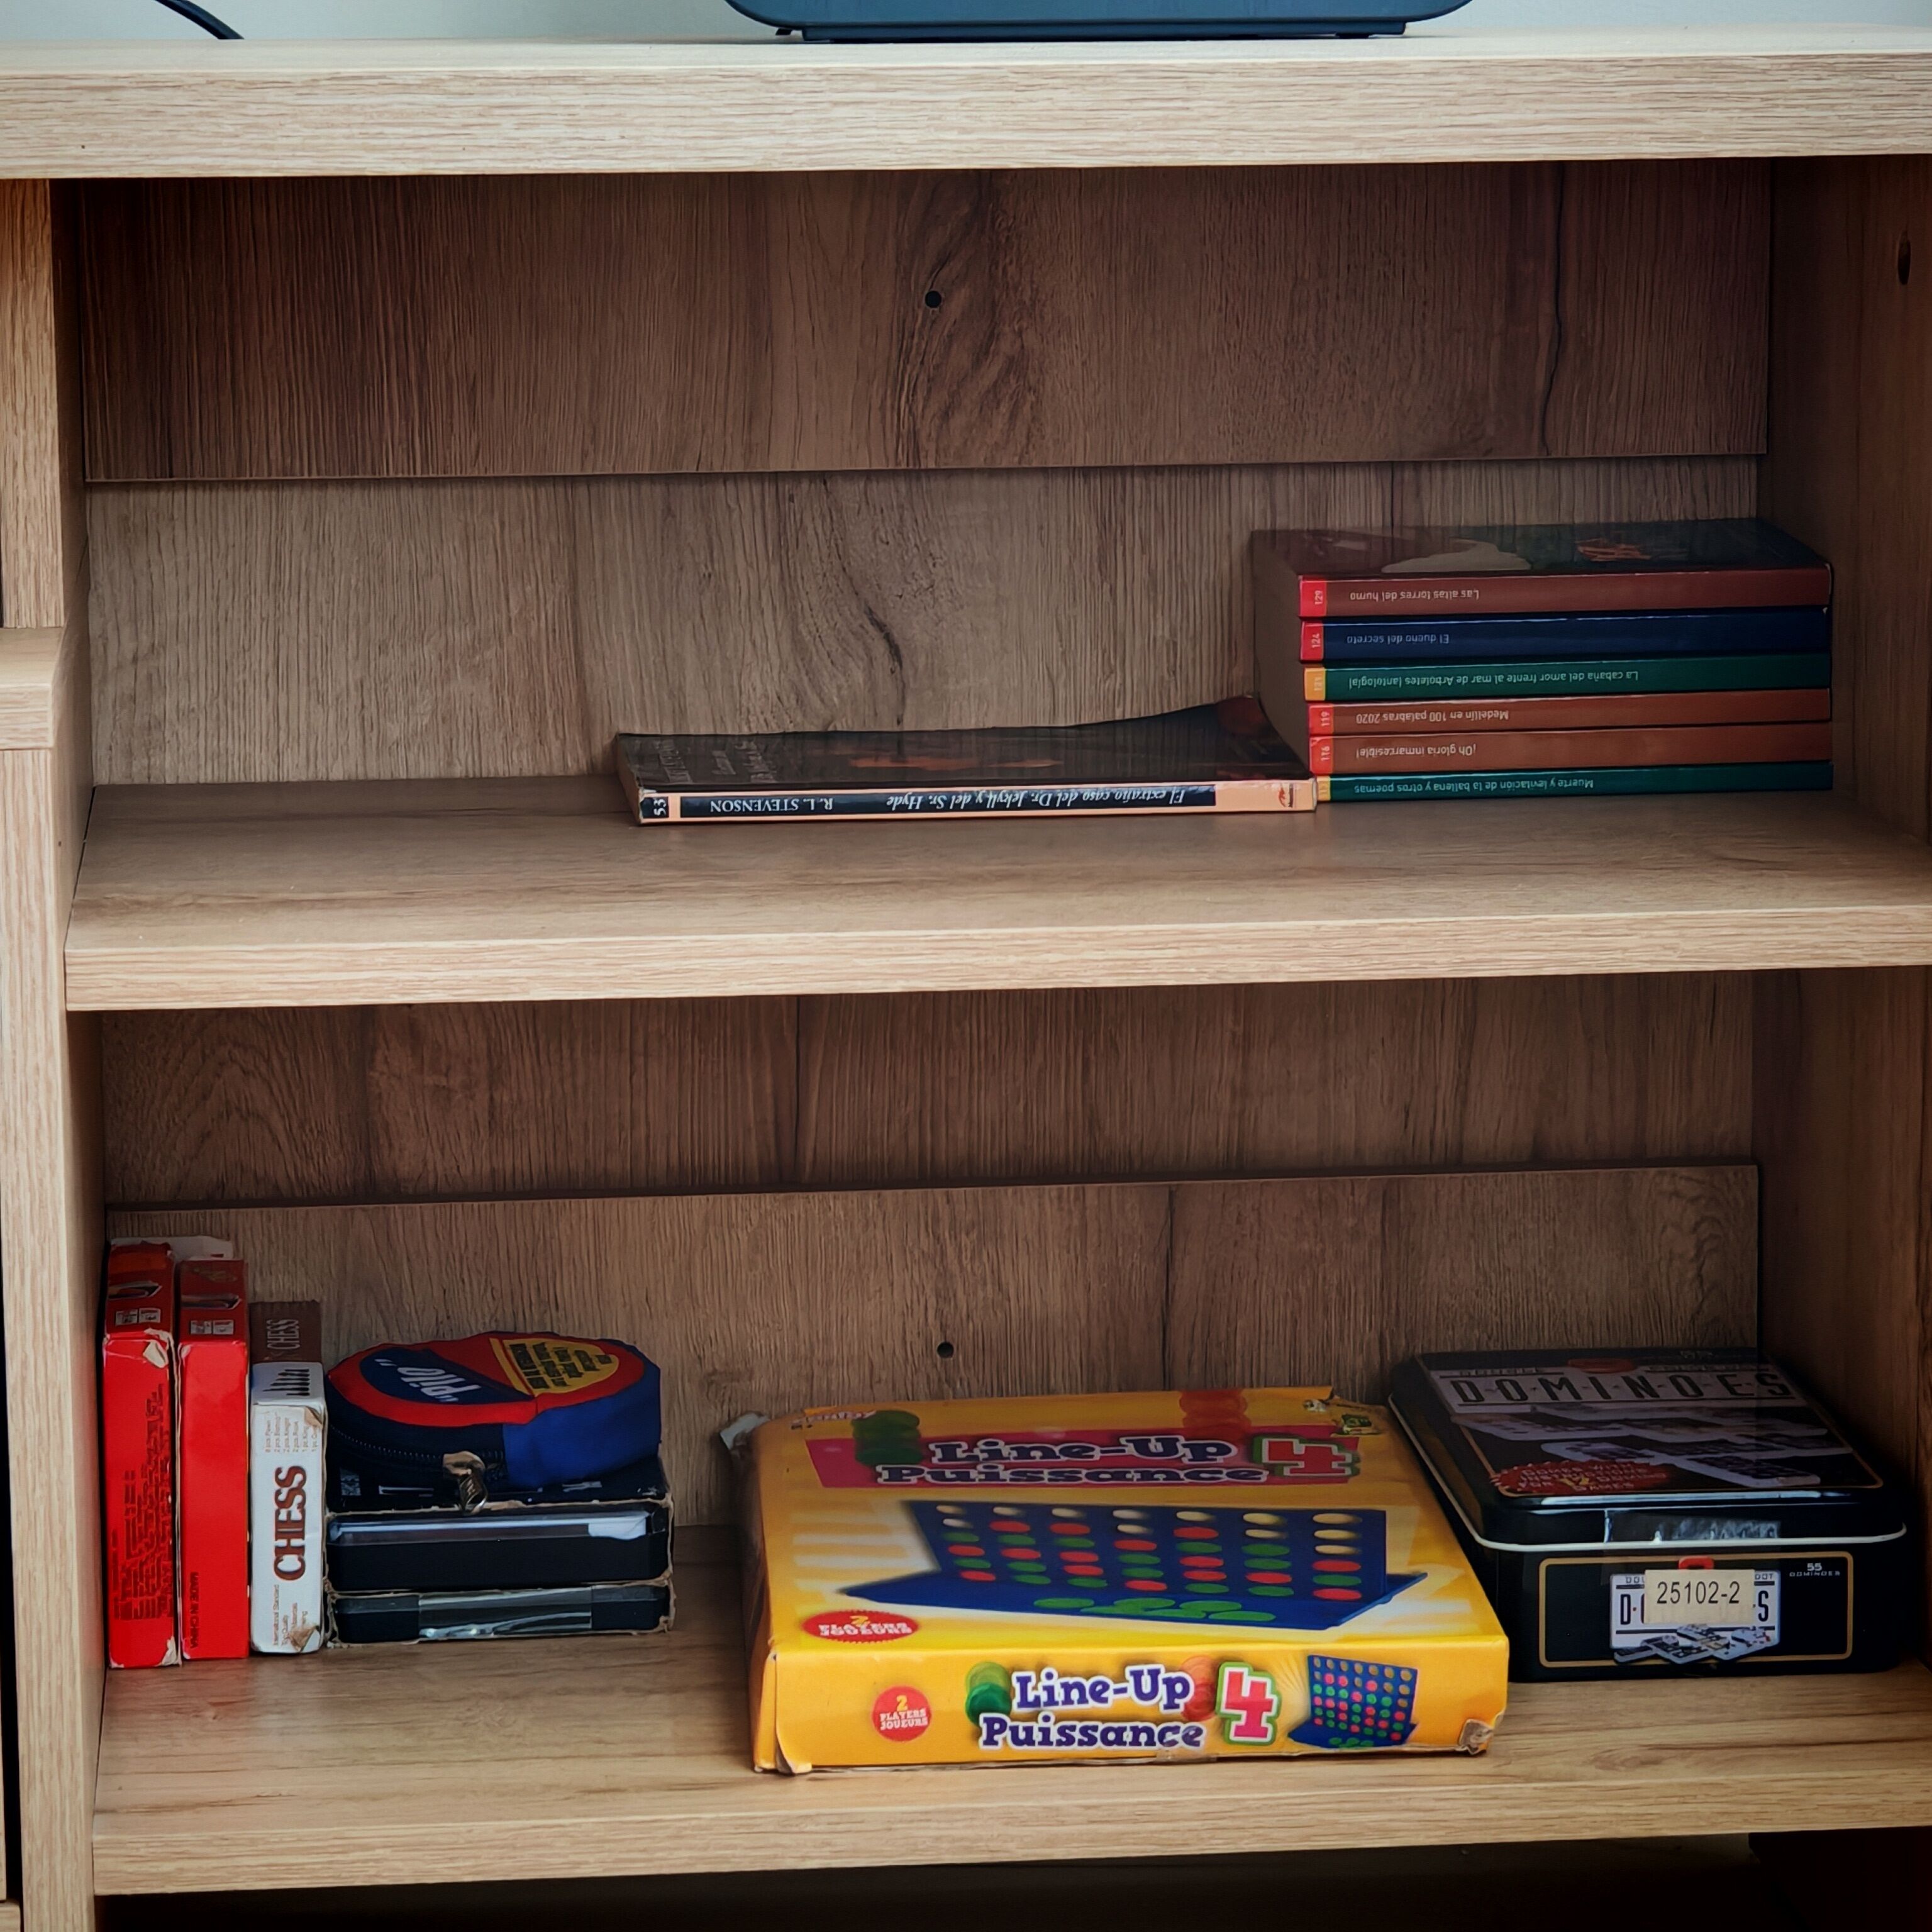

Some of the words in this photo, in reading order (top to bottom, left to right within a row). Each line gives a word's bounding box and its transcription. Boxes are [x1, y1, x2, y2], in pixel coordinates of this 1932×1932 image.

[1350, 592, 1379, 602] humo
[1382, 591, 1398, 601] del
[1400, 591, 1431, 600] torres
[1433, 590, 1458, 600] altas
[1461, 589, 1479, 601] Las
[1347, 635, 1384, 644] secreto
[1387, 635, 1403, 644] del
[1440, 633, 1449, 644] El
[1404, 675, 1453, 686] Arboletes
[1456, 675, 1468, 685] de
[1471, 675, 1492, 683] mar
[1495, 674, 1504, 684] al
[1506, 674, 1537, 684] frente
[1540, 673, 1567, 681] amor
[1569, 672, 1585, 682] del
[1587, 672, 1623, 682] cabaña
[1626, 671, 1638, 681] La
[1321, 711, 1330, 727] 119
[1356, 713, 1380, 724] 2020
[1382, 710, 1426, 723] palabras
[1429, 711, 1446, 722] 100
[1450, 711, 1463, 719] en
[1465, 710, 1509, 721] Medellín
[1356, 747, 1424, 758] inmarcesible!
[1427, 744, 1456, 757] gloria
[1397, 783, 1423, 792] otros
[1424, 781, 1431, 791] y
[1433, 782, 1470, 792] ballena
[1473, 782, 1482, 791] la
[1485, 782, 1497, 792] de
[1550, 777, 1556, 787] y
[1557, 779, 1594, 789] Muerte
[1354, 782, 1394, 794] poemas
[975, 791, 985, 804] y
[985, 789, 1028, 809] Jekyll
[1030, 792, 1052, 808] Dr.
[1057, 789, 1079, 808] del
[1082, 789, 1110, 801] caso
[1114, 788, 1167, 804] extraño
[1169, 786, 1185, 804] El
[710, 797, 799, 813] STEVENSON
[803, 798, 815, 811] L.
[819, 797, 834, 811] R.
[886, 792, 923, 811] Hyde
[928, 794, 948, 810] Sr.
[949, 793, 972, 809] del
[653, 798, 667, 816] 53
[266, 1319, 301, 1350] CHESS
[931, 1436, 1236, 1463] Line-Up
[1258, 1438, 1352, 1477] 4
[879, 1466, 1267, 1485] Puissance
[273, 1465, 306, 1581] CHESS
[1807, 1563, 1823, 1572] 55
[1656, 1580, 1740, 1605] 25102-2
[896, 1694, 908, 1711] 2
[1015, 1667, 1191, 1711] Line-Up
[1223, 1668, 1275, 1741] 4
[880, 1708, 926, 1722] PLAYERS
[880, 1717, 928, 1730] JOUEURS
[982, 1716, 1203, 1749] Puissance
